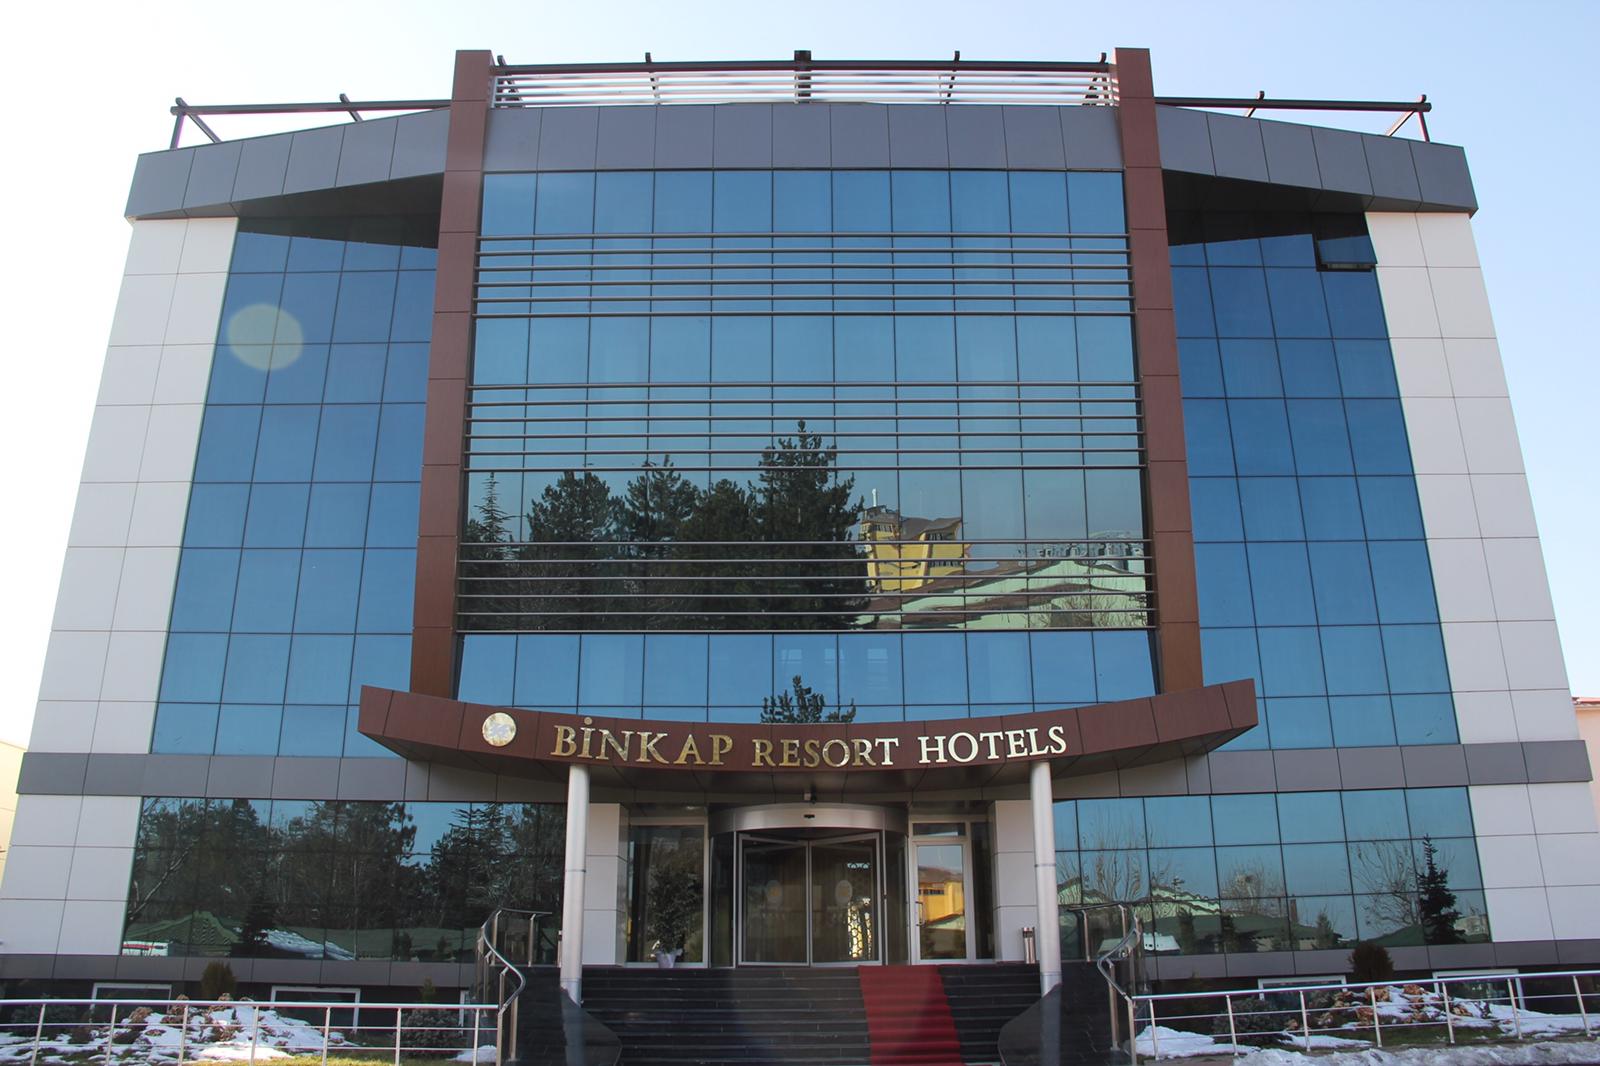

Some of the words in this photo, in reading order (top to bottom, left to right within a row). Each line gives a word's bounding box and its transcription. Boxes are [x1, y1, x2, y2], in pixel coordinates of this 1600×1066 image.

[550, 716, 733, 765] BİNKAP
[751, 738, 899, 767] RESORT
[917, 725, 1067, 764] HOTELS
